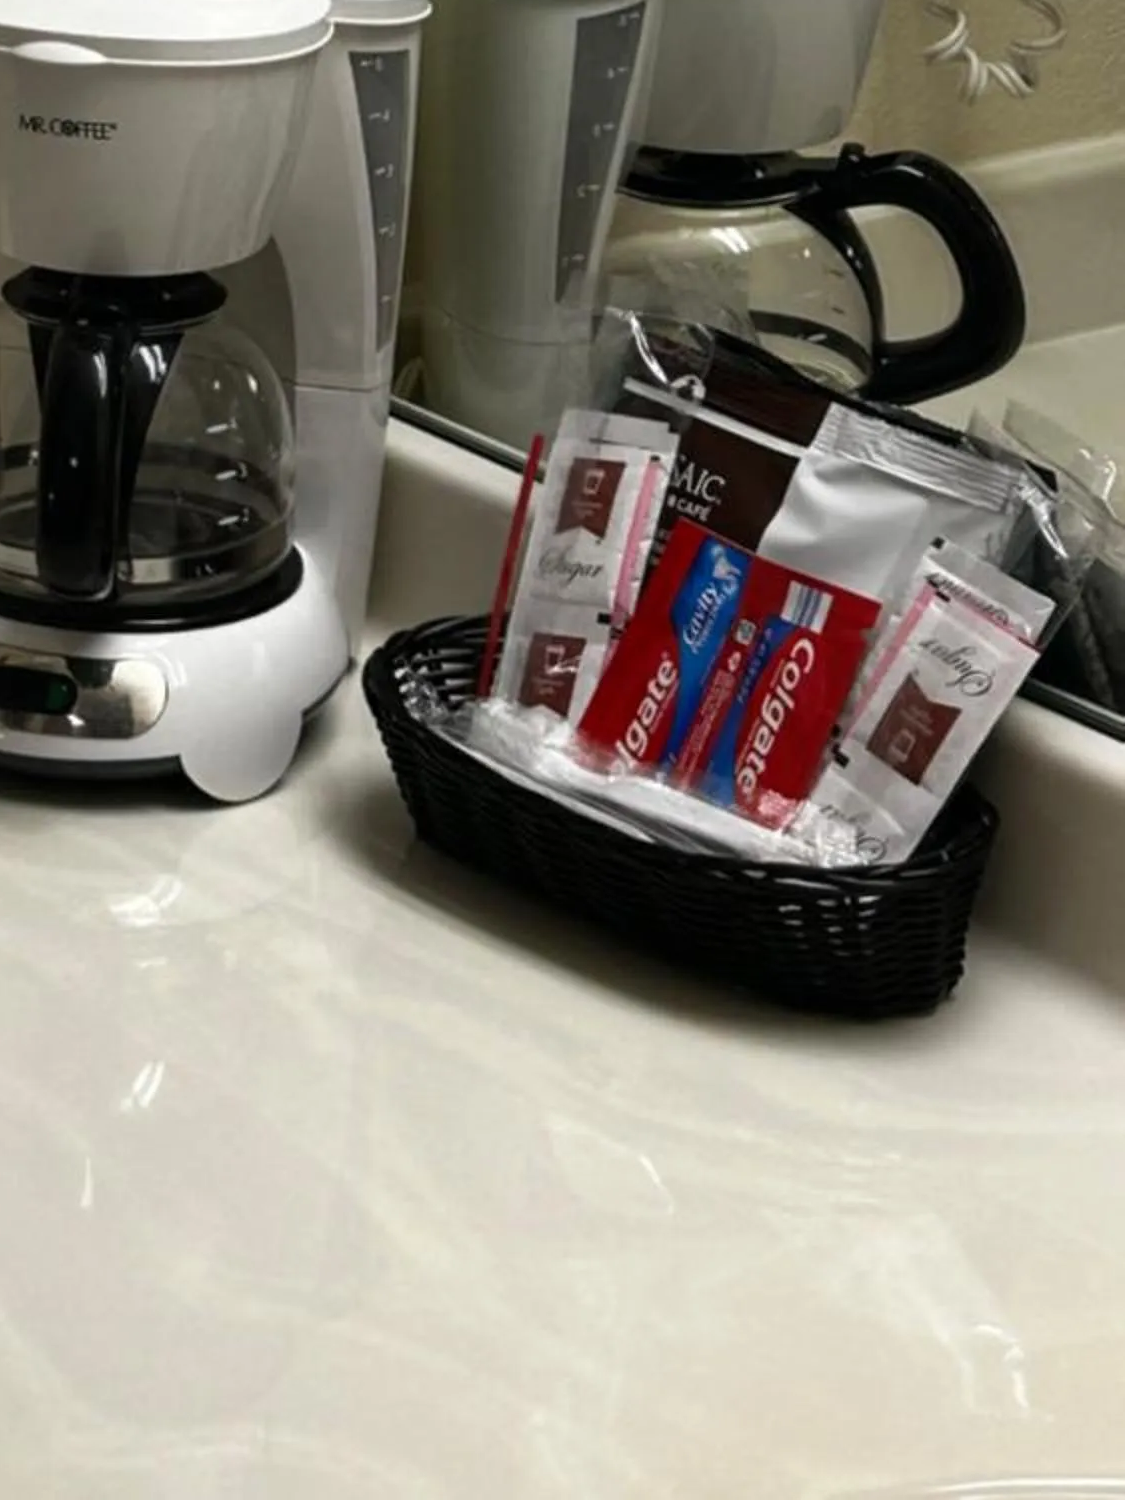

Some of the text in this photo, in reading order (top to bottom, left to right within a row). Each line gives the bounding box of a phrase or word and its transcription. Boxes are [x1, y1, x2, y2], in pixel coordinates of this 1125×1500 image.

[49, 117, 113, 141] COFFEE
[538, 543, 605, 588] Sugar
[682, 579, 720, 646] Cavity
[920, 638, 995, 697] Sugar
[609, 658, 678, 782] olgate
[737, 636, 816, 798] Colgate
